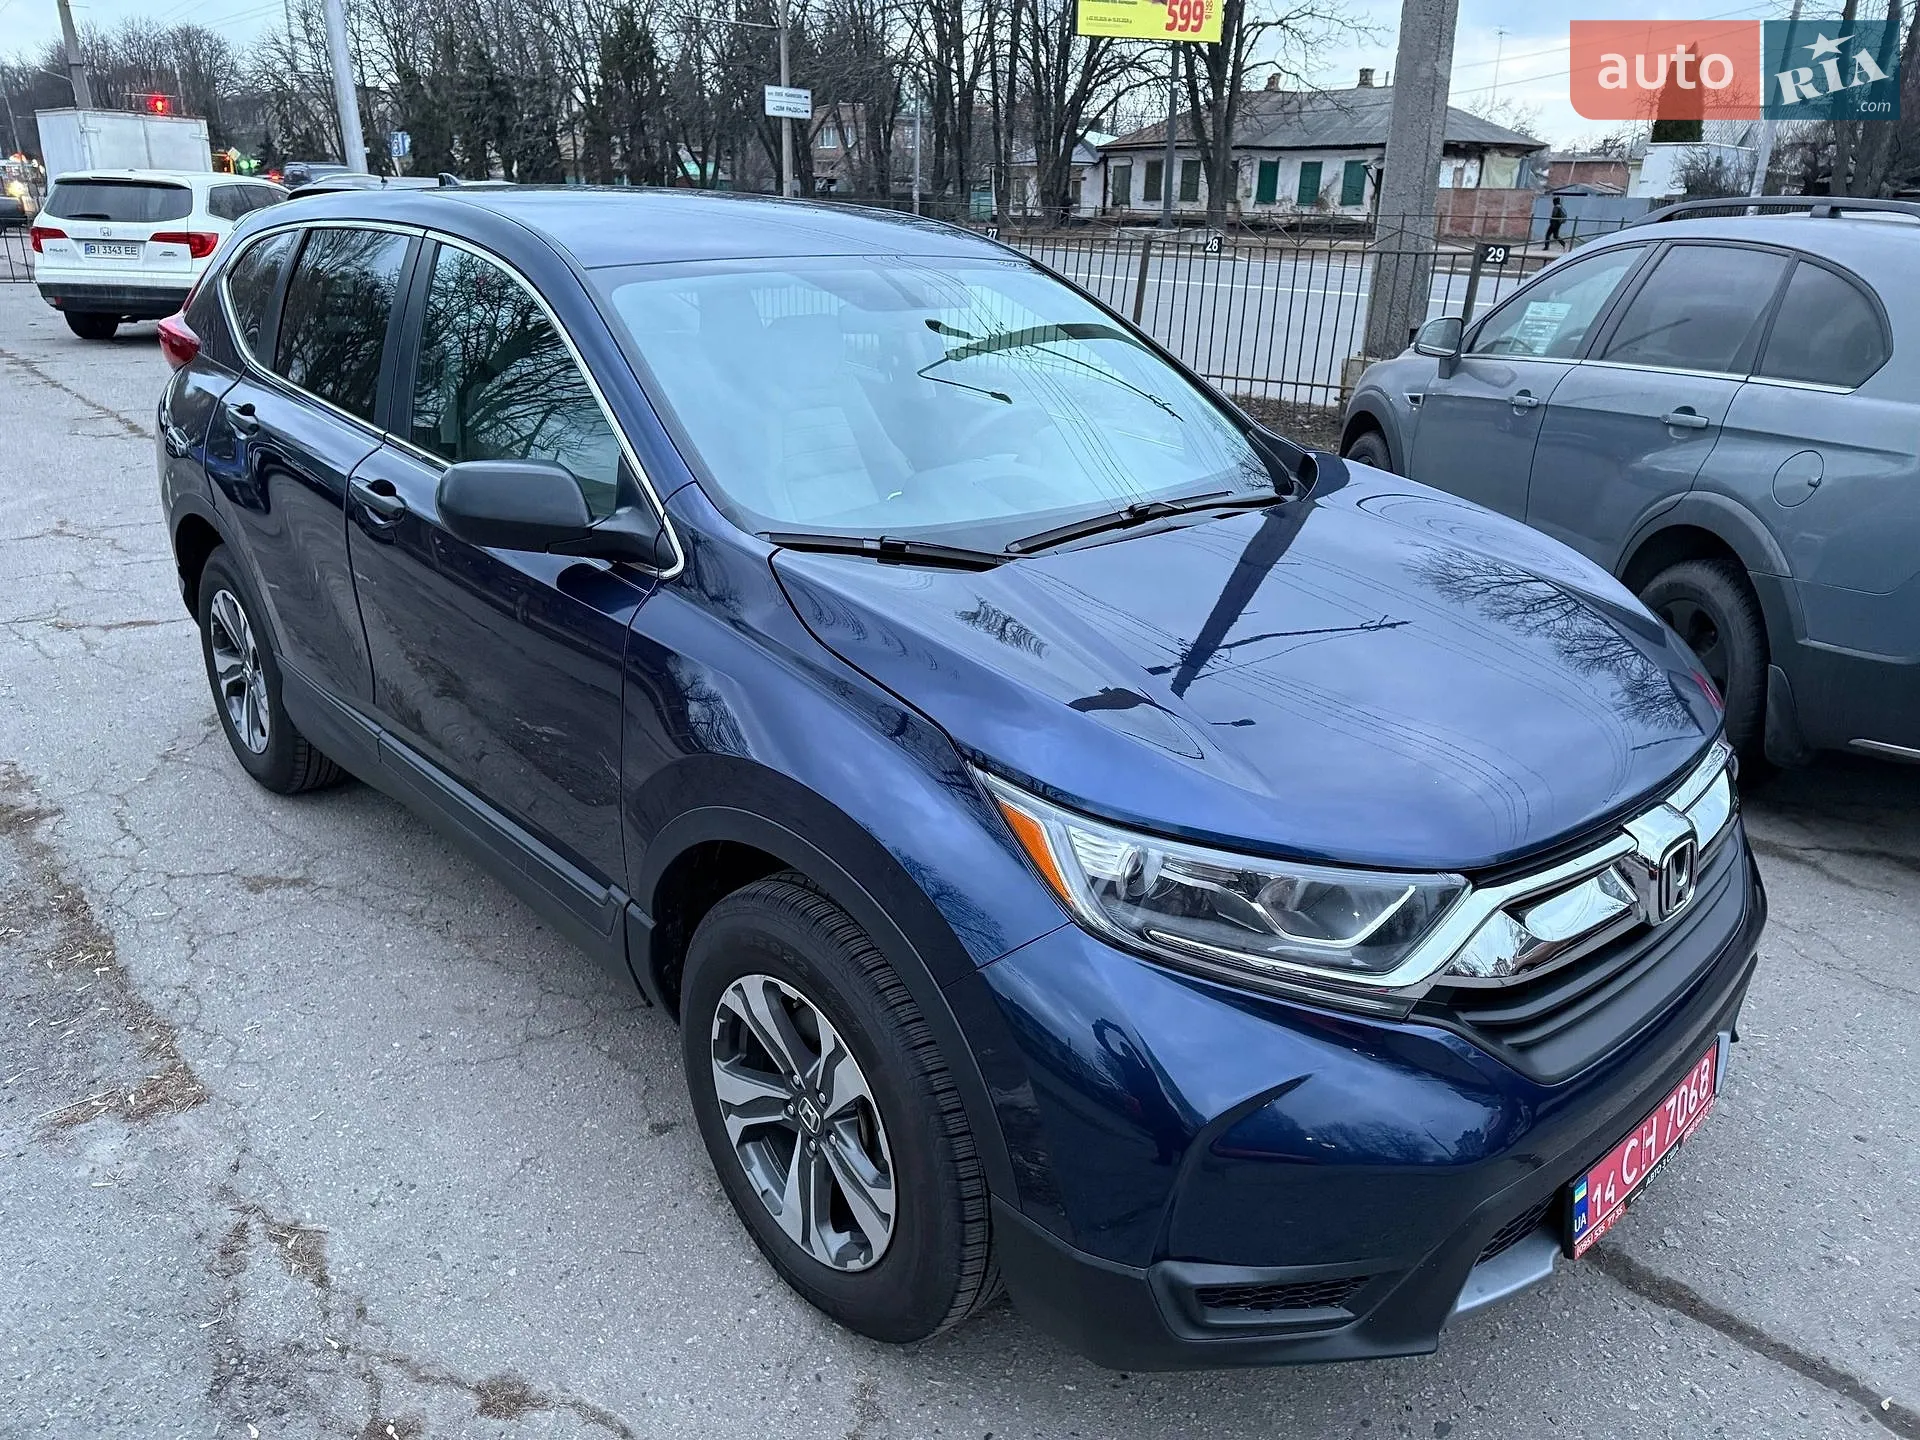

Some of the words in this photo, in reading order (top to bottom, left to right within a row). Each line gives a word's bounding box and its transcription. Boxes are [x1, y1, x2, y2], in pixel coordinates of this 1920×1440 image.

[1165, 0, 1205, 32] 599
[987, 228, 998, 240] 27
[103, 245, 122, 255] 3343
[124, 246, 138, 255] EE
[1206, 238, 1220, 252] 28
[1486, 246, 1505, 263] 29
[1592, 1170, 1616, 1217] 14
[1621, 1116, 1657, 1185] CH
[1664, 1057, 1710, 1145] 7068
[1646, 1164, 1662, 1187] АВТО
[1574, 1212, 1587, 1233] UA
